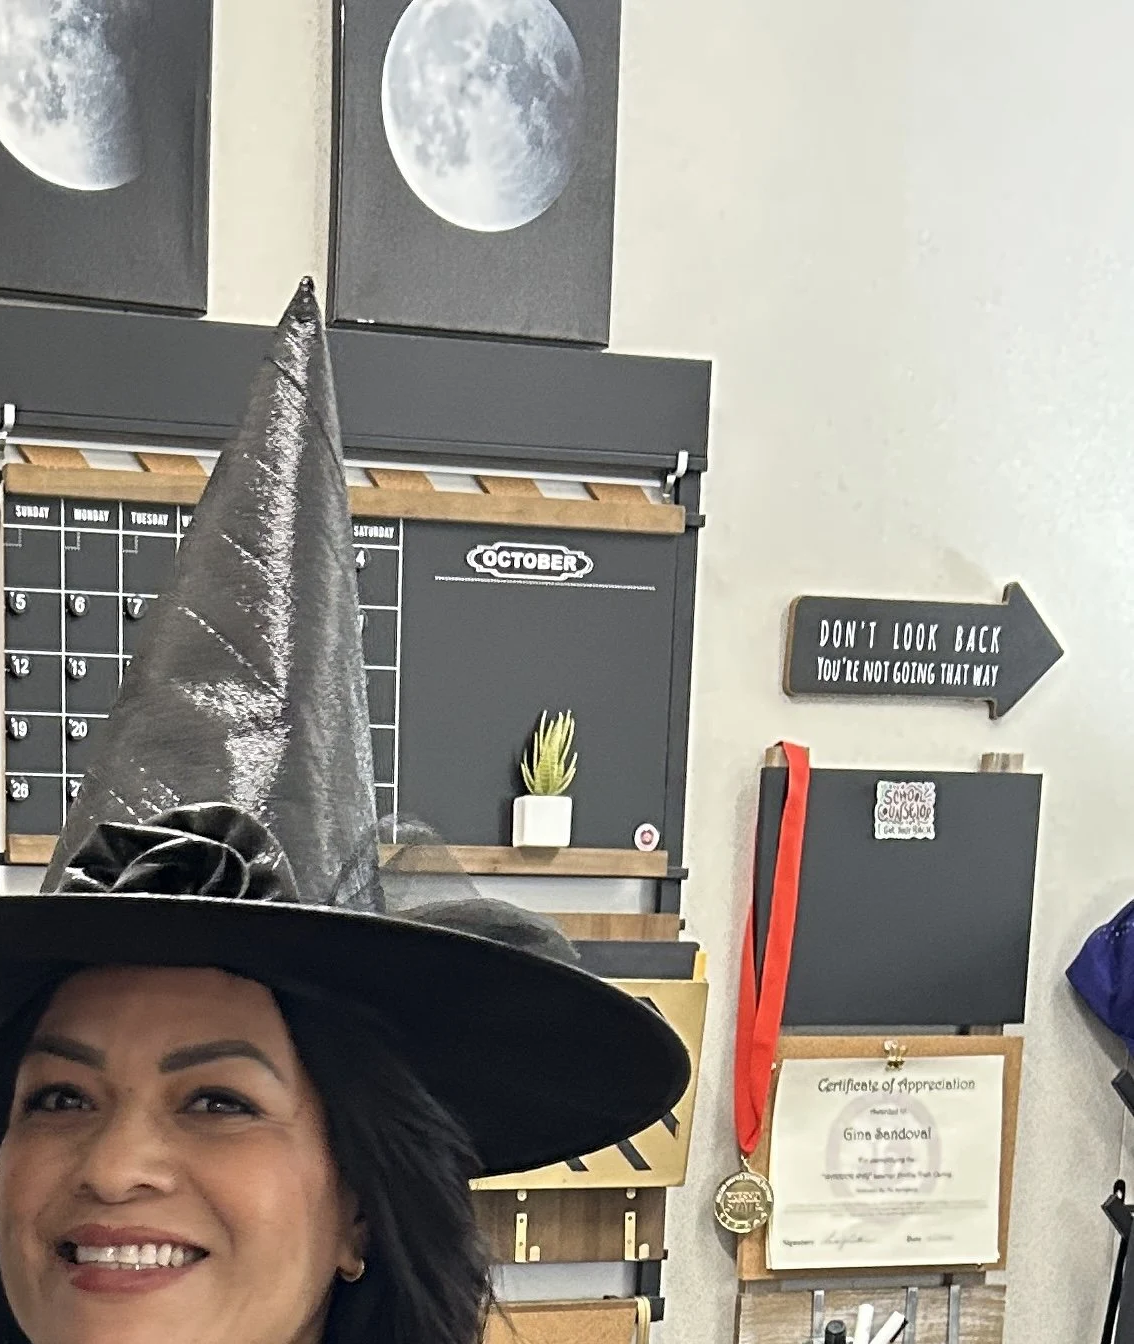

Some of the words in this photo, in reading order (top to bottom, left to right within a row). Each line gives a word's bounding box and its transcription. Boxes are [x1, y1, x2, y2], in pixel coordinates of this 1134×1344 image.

[15, 504, 51, 519] SUNDAY
[73, 508, 111, 523] MONDAY
[130, 511, 170, 527] TUESDAY
[353, 525, 395, 540] SATURDAY
[482, 550, 578, 572] OCTOBER
[15, 594, 26, 610] 5
[74, 596, 86, 613] 6
[133, 597, 143, 615] 7
[819, 619, 877, 649] DON'T
[893, 622, 939, 651] LOOK
[954, 625, 1003, 654] BACK
[15, 658, 30, 674] 12
[70, 660, 87, 676] 13
[863, 660, 890, 683] NOT
[892, 661, 936, 685] GOING
[940, 662, 970, 686] THAT
[973, 664, 999, 688] WAY
[12, 721, 28, 737] 19
[70, 721, 88, 738] 20
[12, 783, 29, 799] 26
[883, 787, 927, 806] SCHOOL
[817, 1078, 879, 1096] Certificate
[881, 1077, 896, 1095] of
[897, 1077, 976, 1094] Appreciation
[843, 1127, 872, 1142] Gina
[874, 1126, 933, 1142] Sandoval
